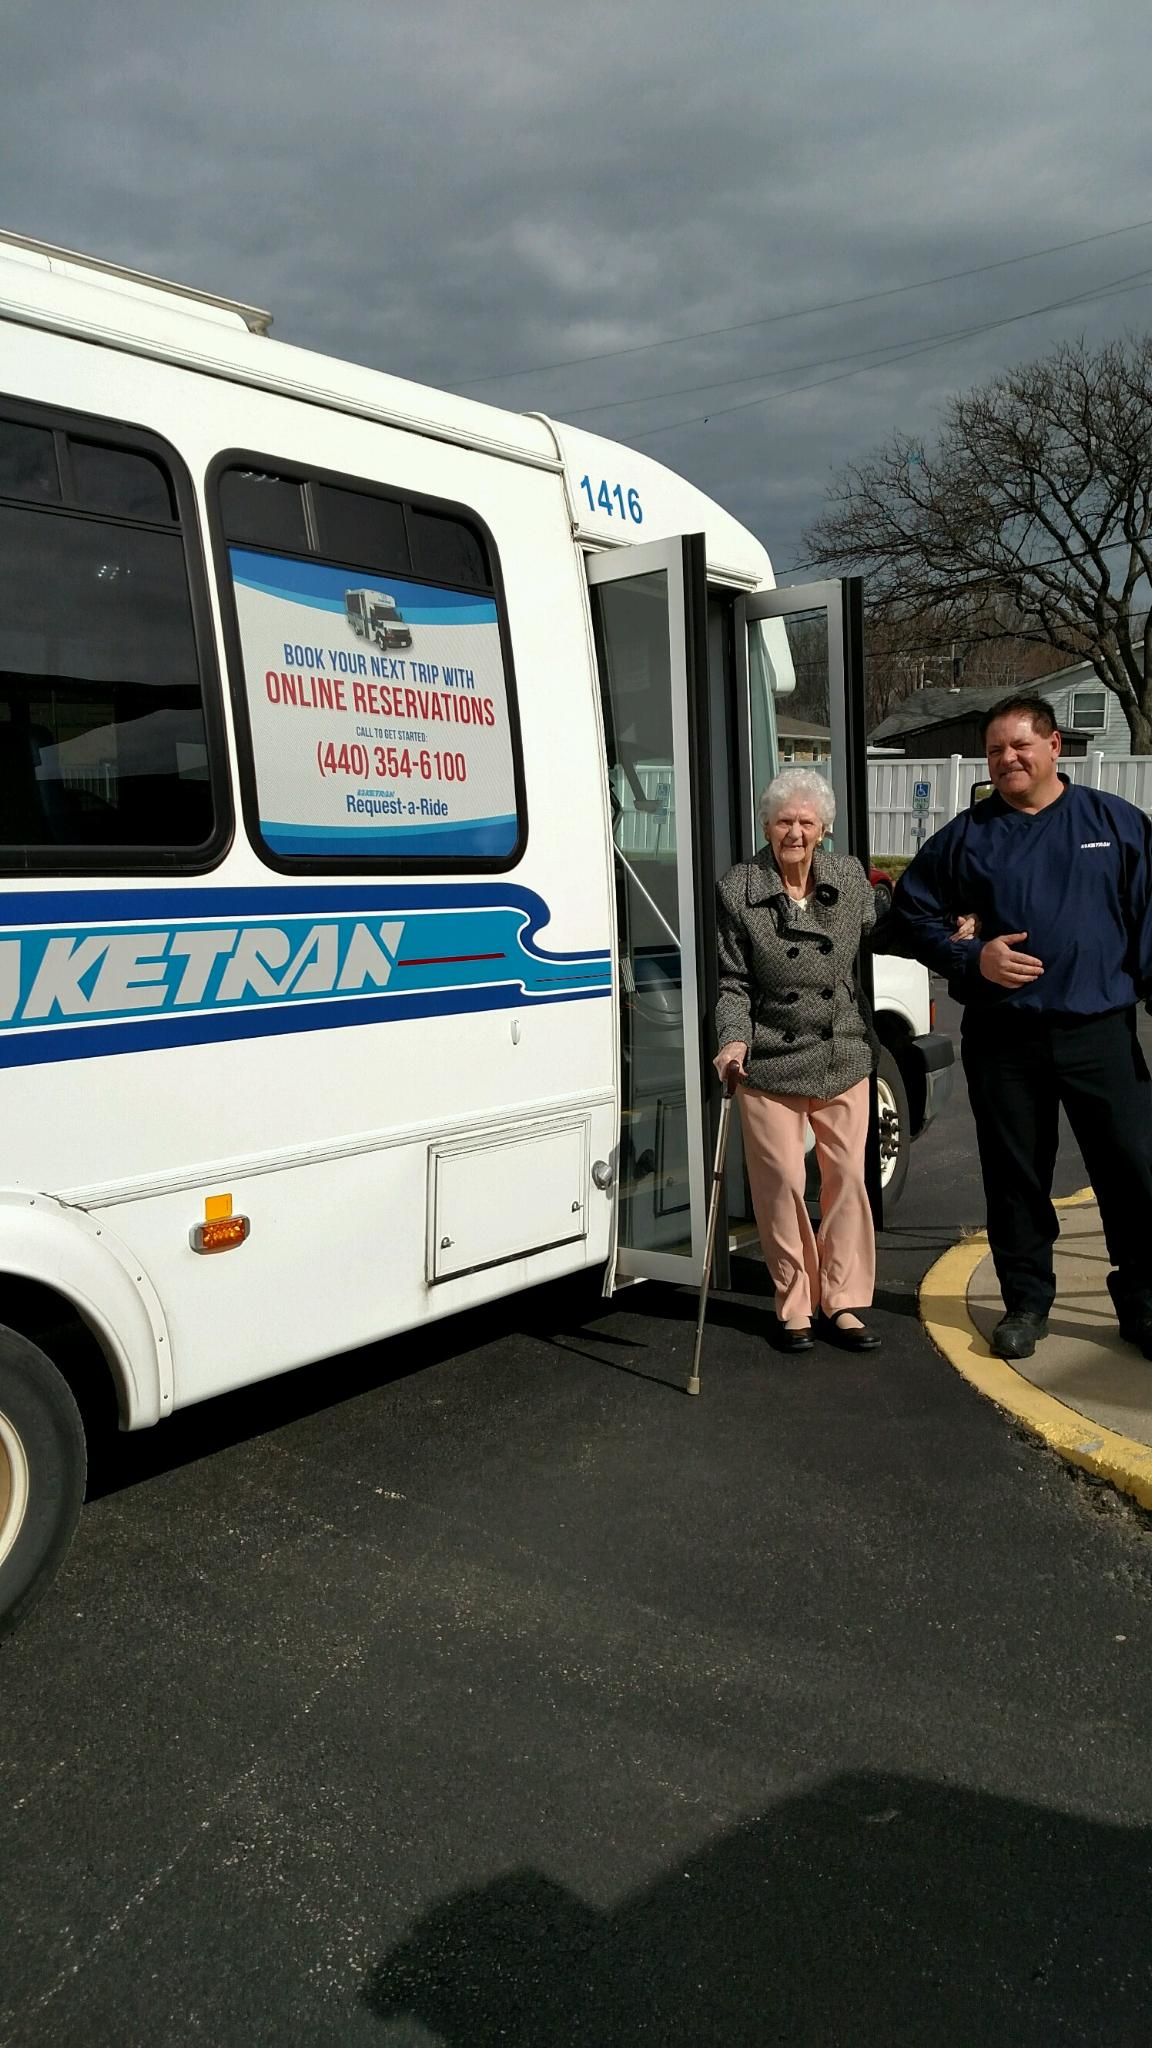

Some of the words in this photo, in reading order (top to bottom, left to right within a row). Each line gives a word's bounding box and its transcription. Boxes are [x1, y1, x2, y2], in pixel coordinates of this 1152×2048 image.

[580, 475, 643, 524] 1416
[283, 643, 325, 670] BOOK
[328, 650, 368, 676] YOUR
[370, 656, 406, 681] NEXT
[410, 661, 439, 685] TRIP
[442, 666, 475, 690] WITH
[265, 670, 348, 711] ONLINE
[352, 681, 496, 726] RESERVATIONS
[356, 726, 373, 738] CALL
[374, 727, 383, 739] TO
[384, 728, 396, 740] GET
[398, 730, 428, 743] STARTED:
[317, 740, 370, 780] (440)
[373, 746, 467, 782] 354-6100
[346, 794, 449, 818] Request-a-Ride
